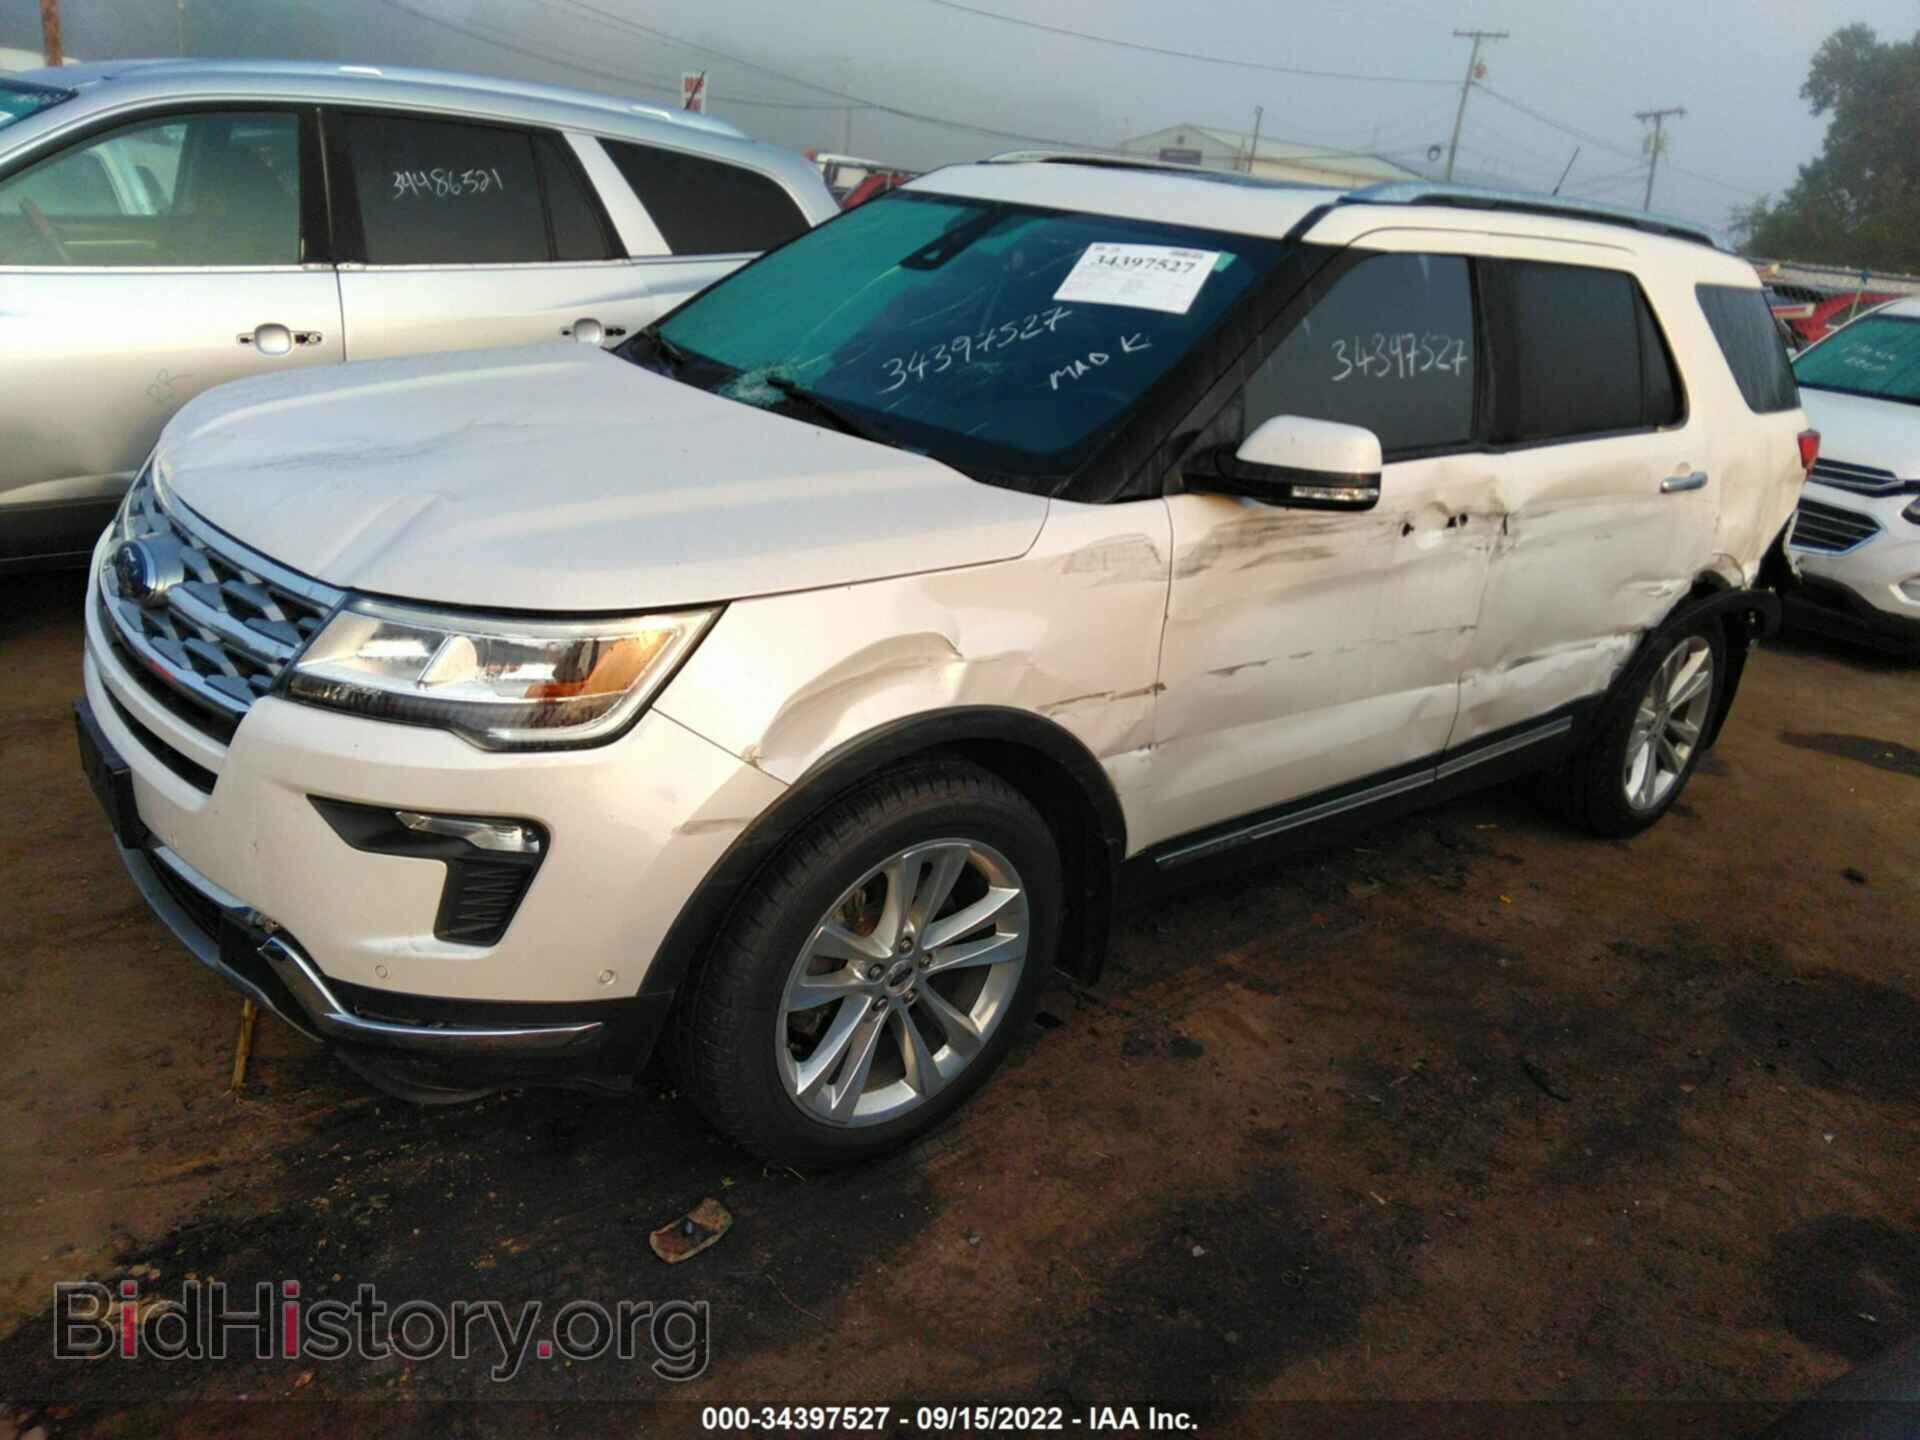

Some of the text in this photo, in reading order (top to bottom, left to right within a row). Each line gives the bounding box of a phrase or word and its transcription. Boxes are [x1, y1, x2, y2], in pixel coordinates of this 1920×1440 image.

[392, 167, 504, 200] 34486521
[1090, 254, 1196, 274] 34397527
[876, 307, 1073, 394] 34397527
[1120, 332, 1153, 353] K
